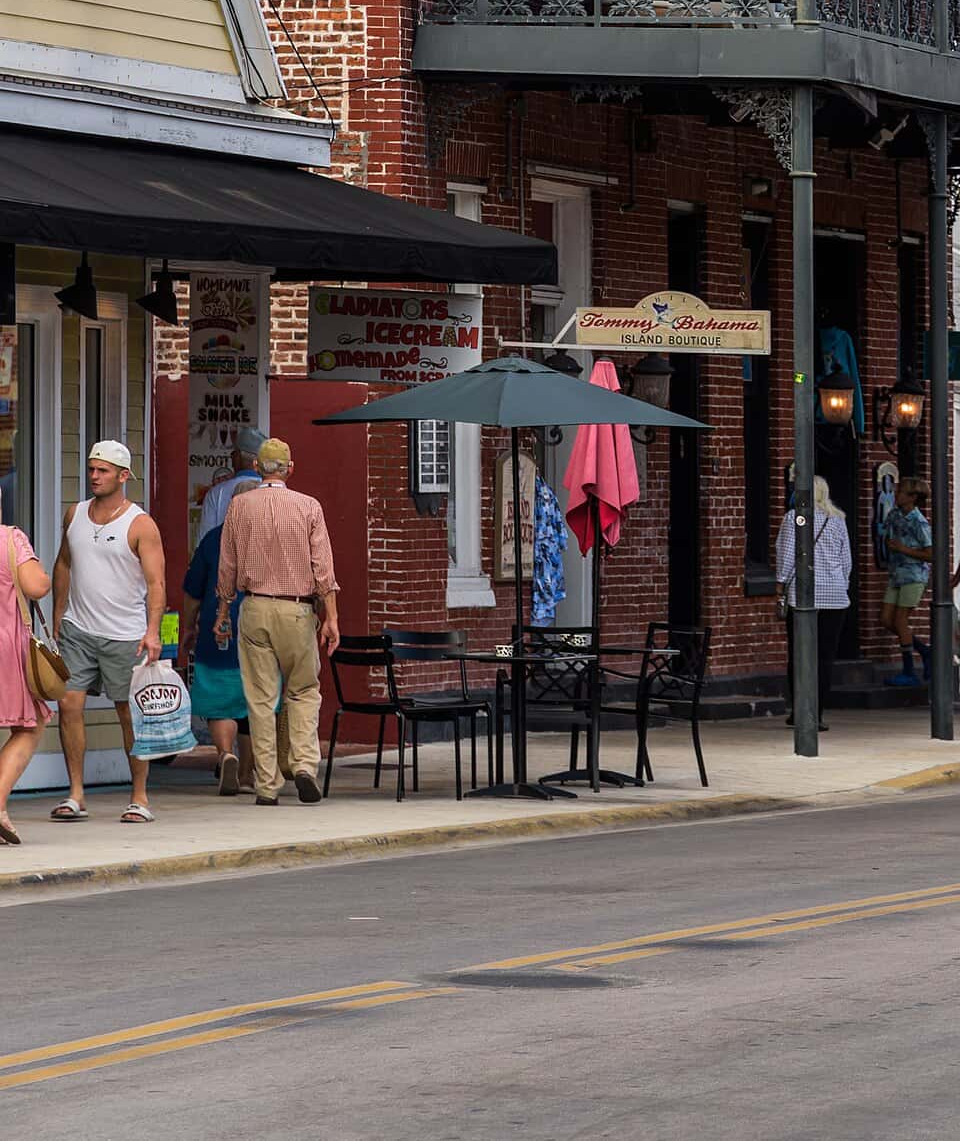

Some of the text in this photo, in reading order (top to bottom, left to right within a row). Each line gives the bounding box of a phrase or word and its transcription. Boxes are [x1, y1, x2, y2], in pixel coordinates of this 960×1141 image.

[315, 292, 448, 320] GLADIATORS
[579, 312, 760, 334] Tommy Bahama
[621, 334, 721, 346] ISLAND BOUTIQUE
[380, 370, 417, 382] FROM
[204, 394, 244, 408] MILK
[198, 408, 251, 423] SHAKE
